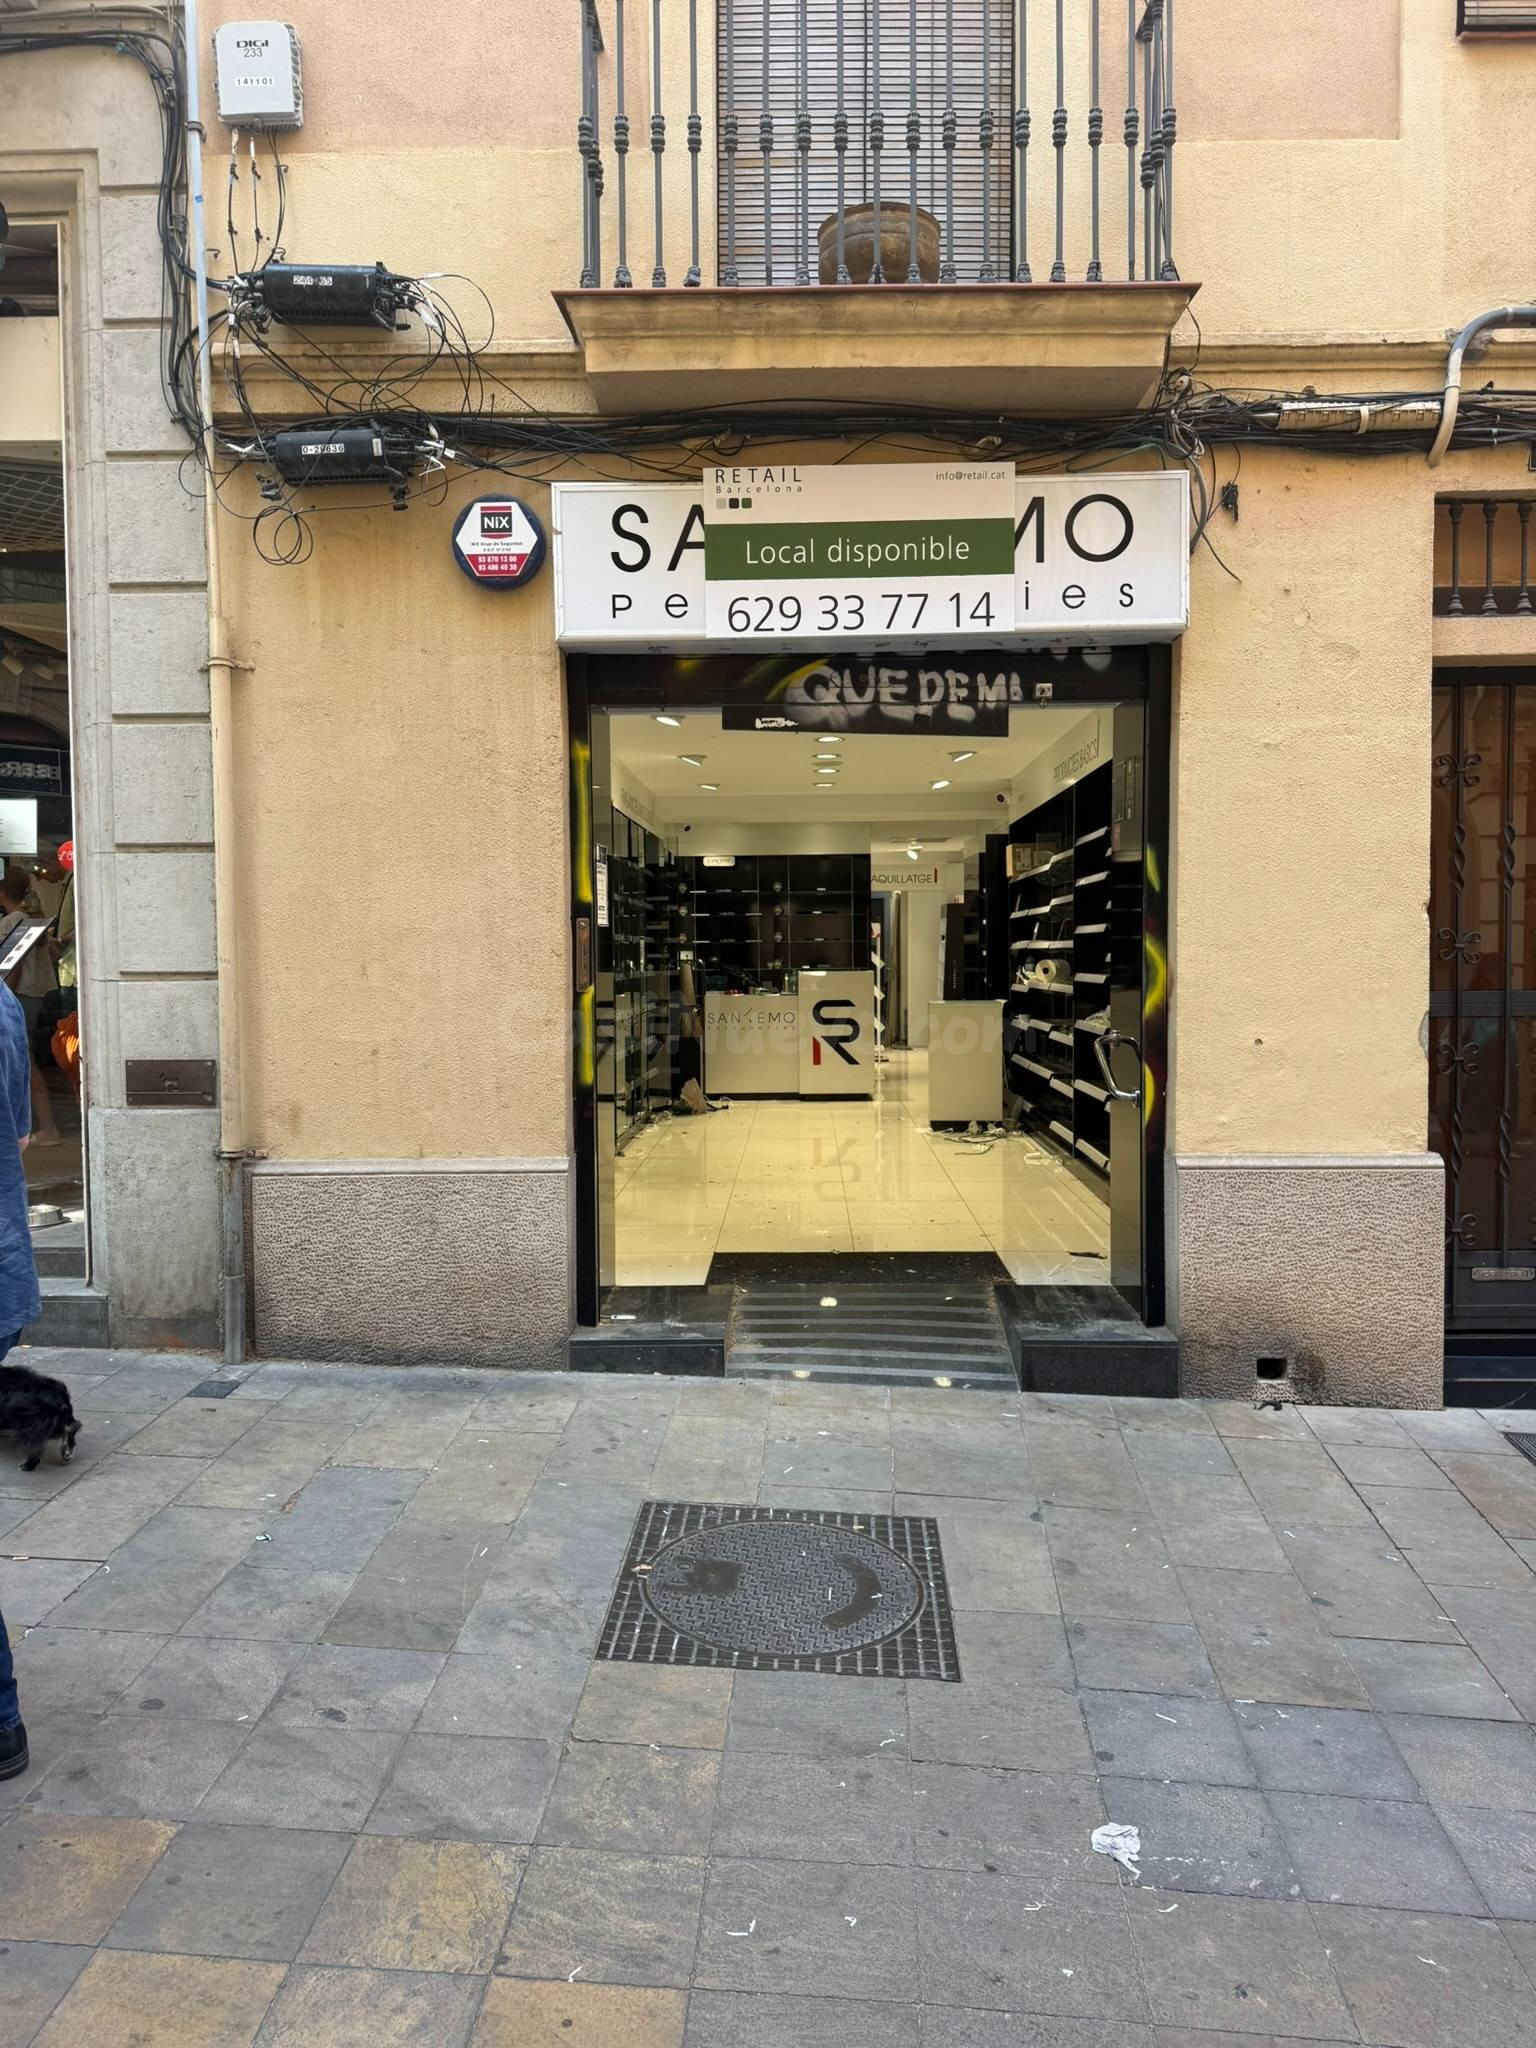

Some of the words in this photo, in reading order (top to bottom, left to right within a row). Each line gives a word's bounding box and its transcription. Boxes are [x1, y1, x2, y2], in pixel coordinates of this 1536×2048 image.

[236, 40, 269, 48] DIGI
[243, 48, 263, 58] 233
[715, 467, 803, 483] RETAIL
[935, 470, 1006, 481] info@retail.cat
[716, 485, 803, 494] Barcelona
[746, 537, 814, 564] Local
[827, 535, 970, 568] disponible
[727, 596, 802, 633] 629
[817, 594, 865, 631] 33
[881, 593, 929, 630] 77
[948, 591, 995, 628] 14
[871, 873, 933, 885] AQUILLATGE
